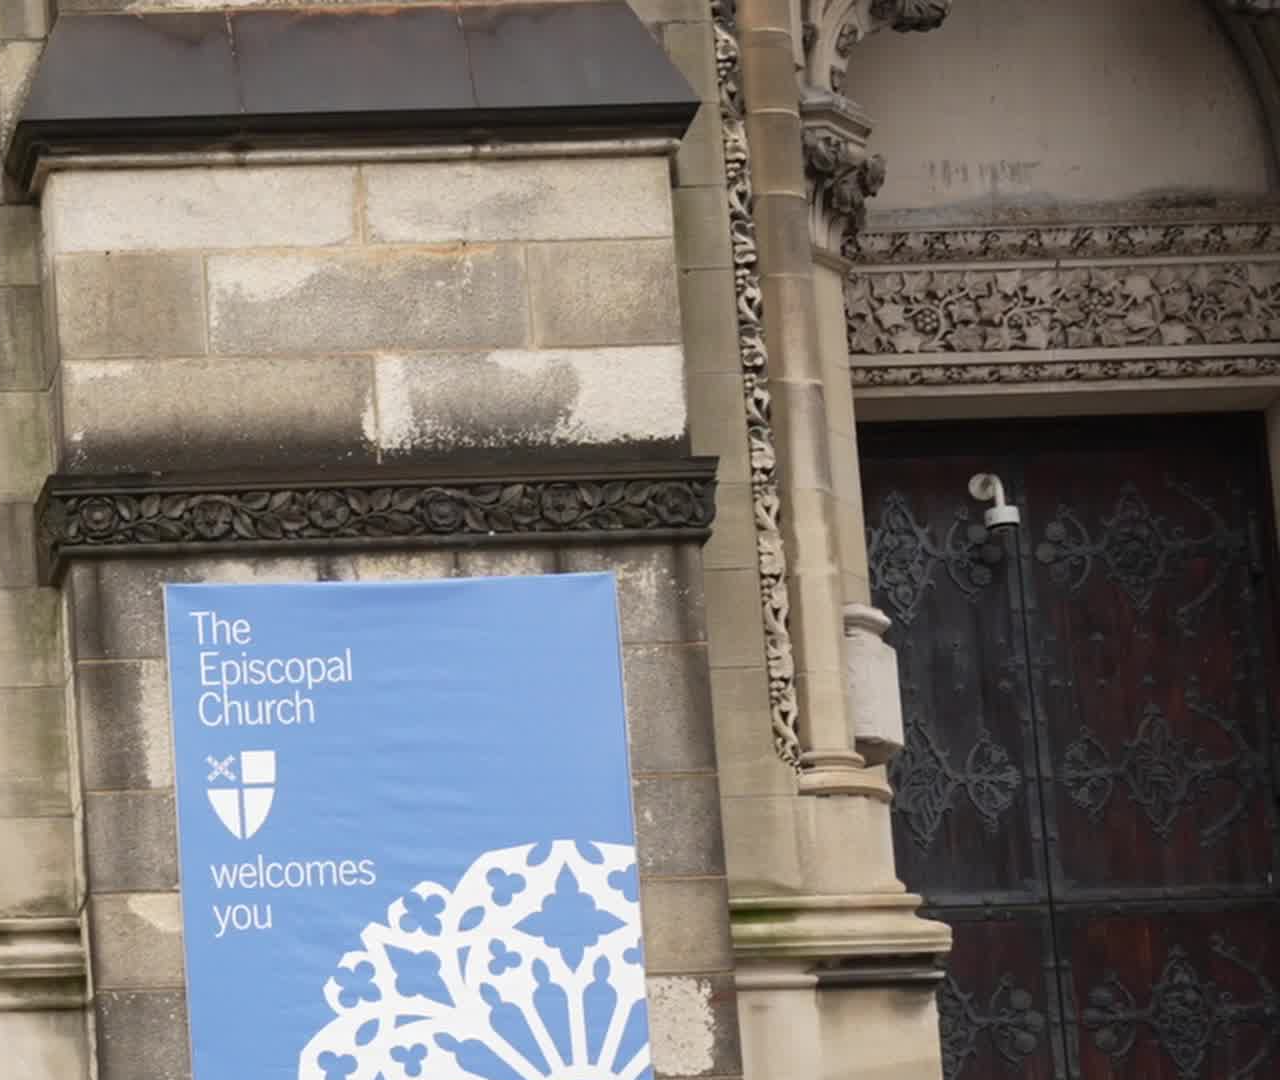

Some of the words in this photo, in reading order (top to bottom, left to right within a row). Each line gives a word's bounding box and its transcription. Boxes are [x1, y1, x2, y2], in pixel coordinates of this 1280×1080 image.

[189, 610, 252, 646] The
[198, 647, 353, 690] Episcopal
[197, 689, 316, 727] Church
[209, 854, 377, 890] welcomes
[212, 904, 273, 939] you
